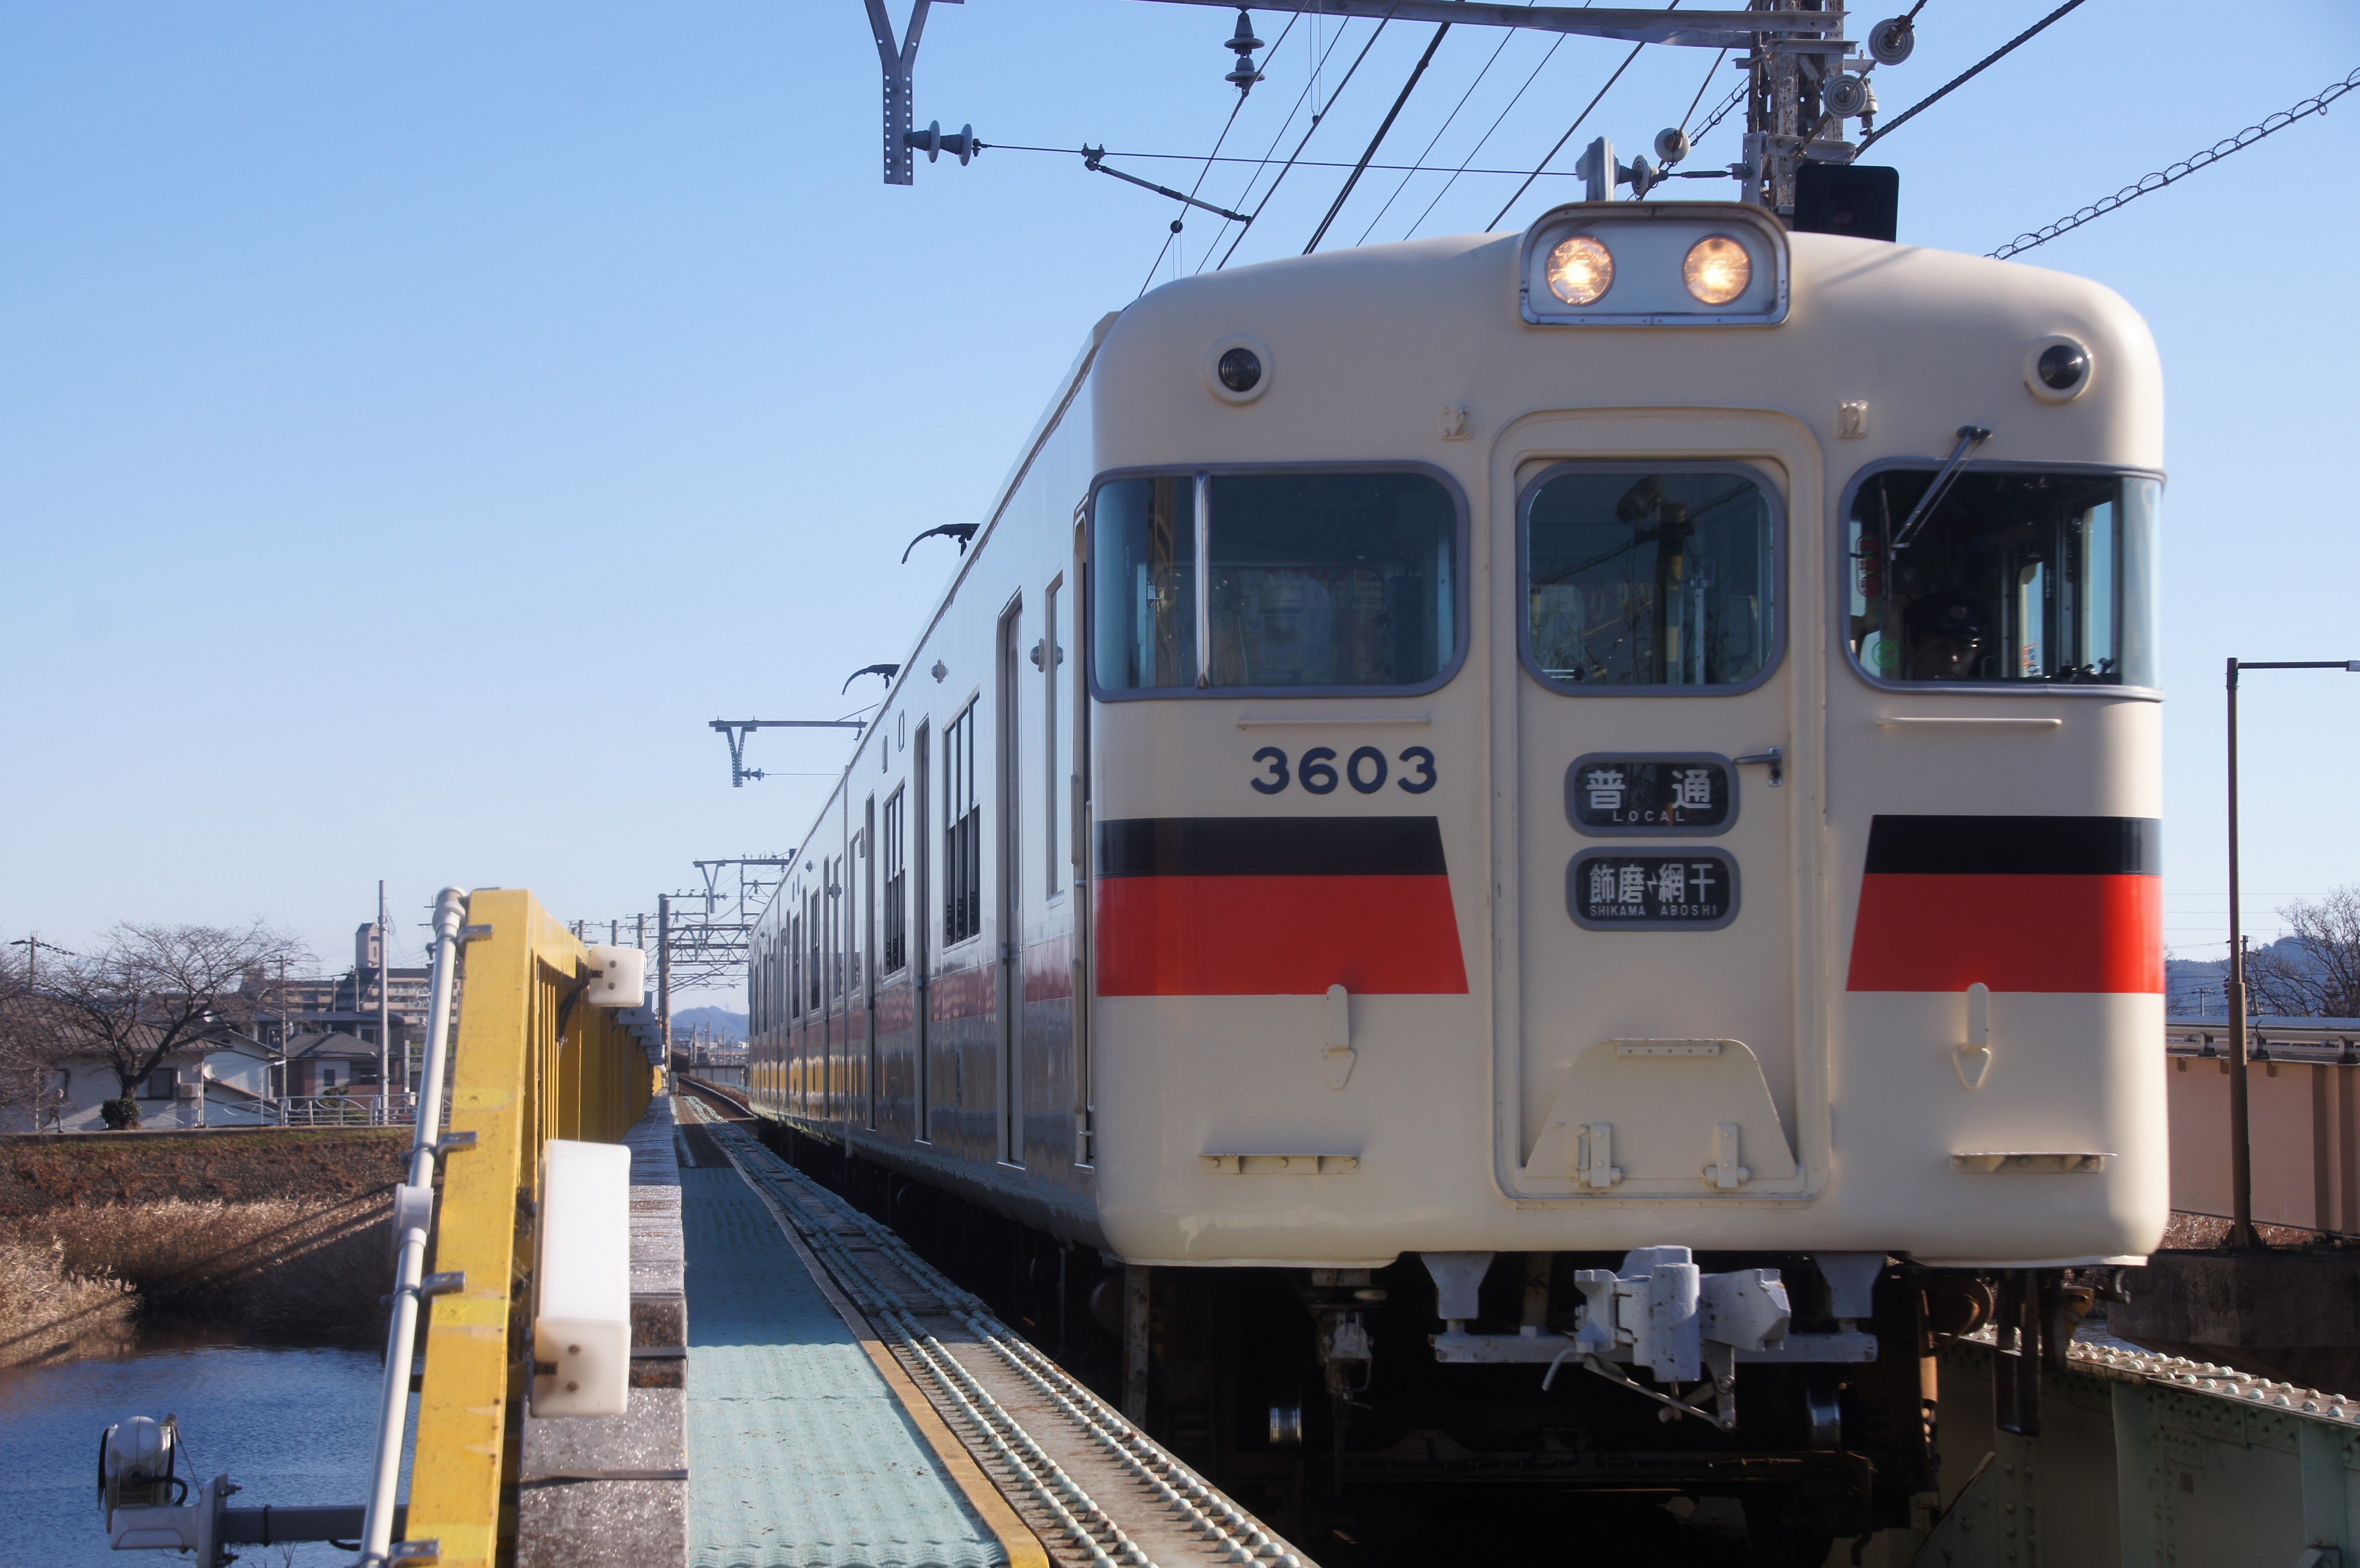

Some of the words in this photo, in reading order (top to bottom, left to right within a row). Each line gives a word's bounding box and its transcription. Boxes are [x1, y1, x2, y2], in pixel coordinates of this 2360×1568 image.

[1250, 746, 1437, 795] 3603
[1586, 769, 1712, 809] 普通
[1613, 810, 1685, 821] LOCAL
[1590, 905, 1646, 916] SHIKAMA
[1660, 905, 1717, 916] ABOSHI
